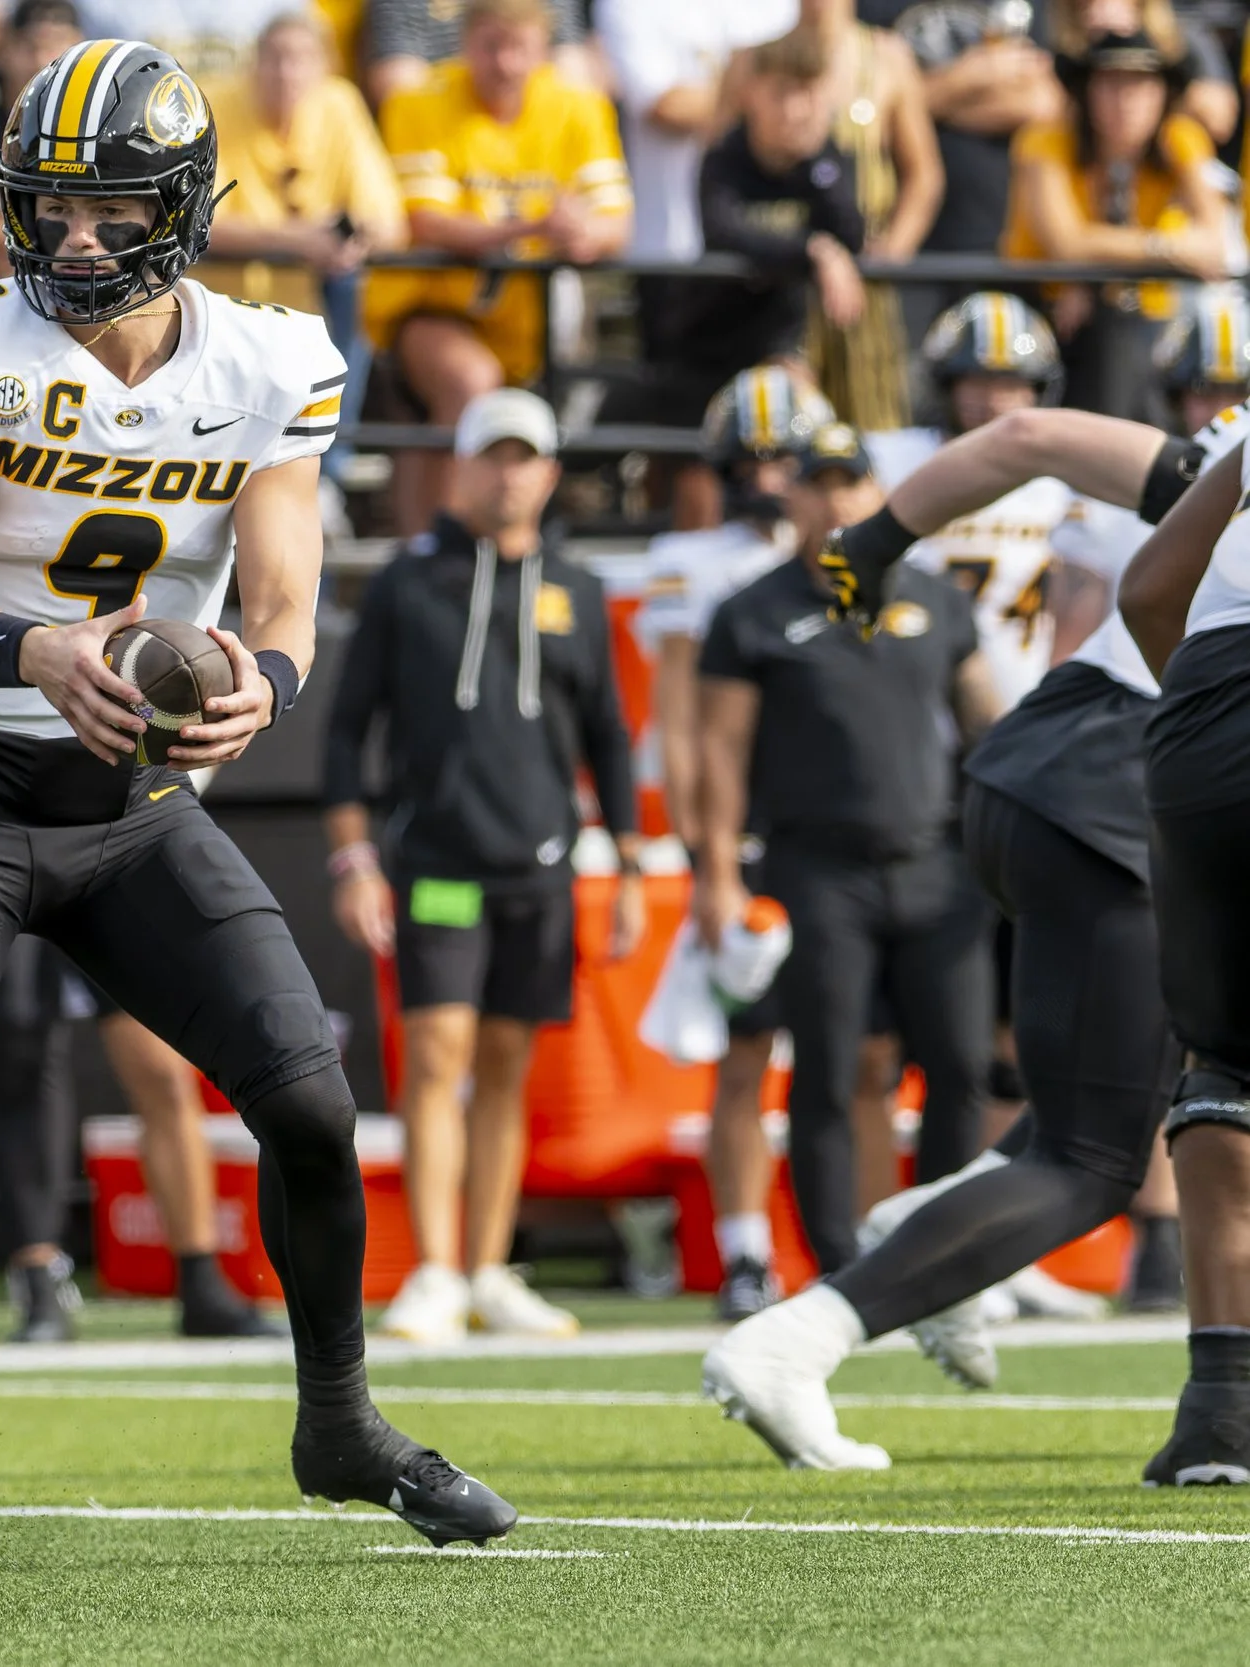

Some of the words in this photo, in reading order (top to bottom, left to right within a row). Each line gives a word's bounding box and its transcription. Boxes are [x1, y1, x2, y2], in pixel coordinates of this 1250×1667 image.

[39, 161, 87, 174] MIZZOU
[41, 379, 87, 442] C
[42, 507, 168, 628] 9
